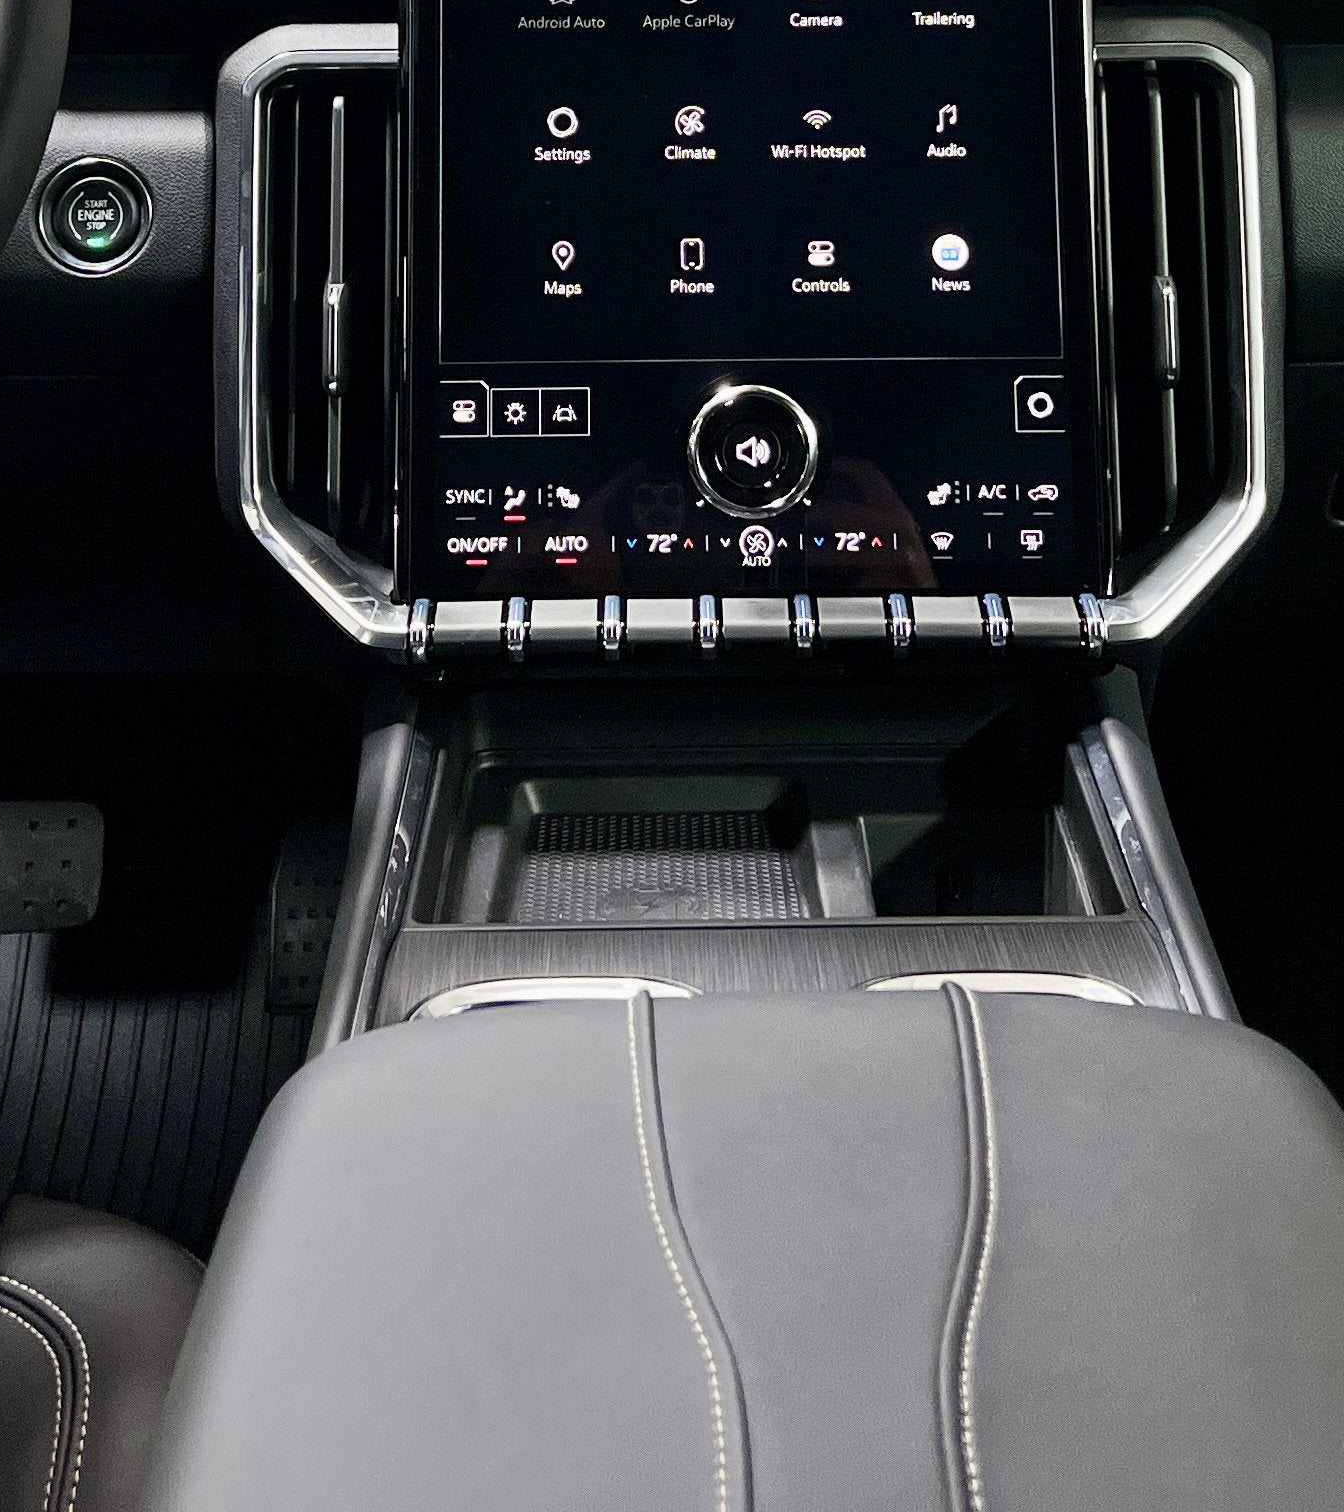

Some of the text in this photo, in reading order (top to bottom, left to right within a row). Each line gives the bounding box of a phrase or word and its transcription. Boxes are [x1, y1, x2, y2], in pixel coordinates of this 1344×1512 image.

[517, 16, 605, 29] Android Auto
[642, 14, 736, 31] Apple CarPlay
[789, 12, 843, 27] Camera
[912, 11, 976, 29] Trailering
[534, 146, 591, 164] Settings
[664, 145, 716, 160] Climate
[770, 144, 866, 161] Wi-Fi Hotspot
[926, 143, 967, 158] Audio
[84, 200, 108, 208] START
[77, 209, 115, 222] ENGINE
[86, 221, 107, 231] STOP
[544, 280, 582, 298] Maps
[670, 279, 715, 294] Phone
[791, 277, 851, 293] Controls
[931, 277, 971, 292] News
[446, 489, 485, 504] SYNC
[978, 484, 1007, 500] A/C
[447, 536, 508, 553] ON/OFF
[545, 535, 588, 552] AUTO
[647, 534, 678, 553] 72°
[834, 531, 866, 552] 72°
[741, 555, 771, 567] AUTO
